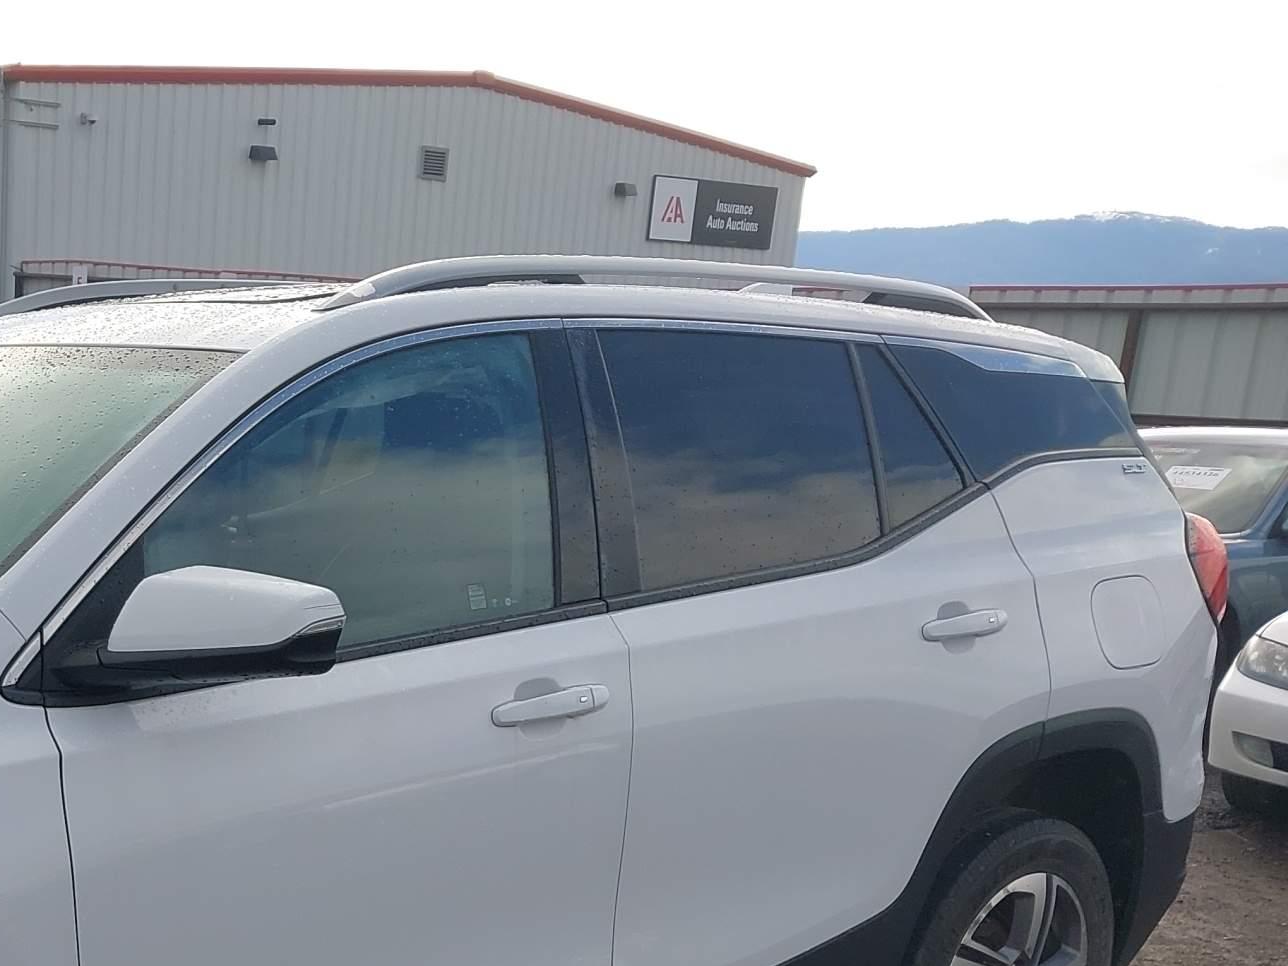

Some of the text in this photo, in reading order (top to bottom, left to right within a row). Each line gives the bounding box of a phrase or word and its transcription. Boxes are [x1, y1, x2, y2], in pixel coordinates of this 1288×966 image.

[715, 198, 754, 215] Insurance
[706, 215, 759, 232] Auto Auctions
